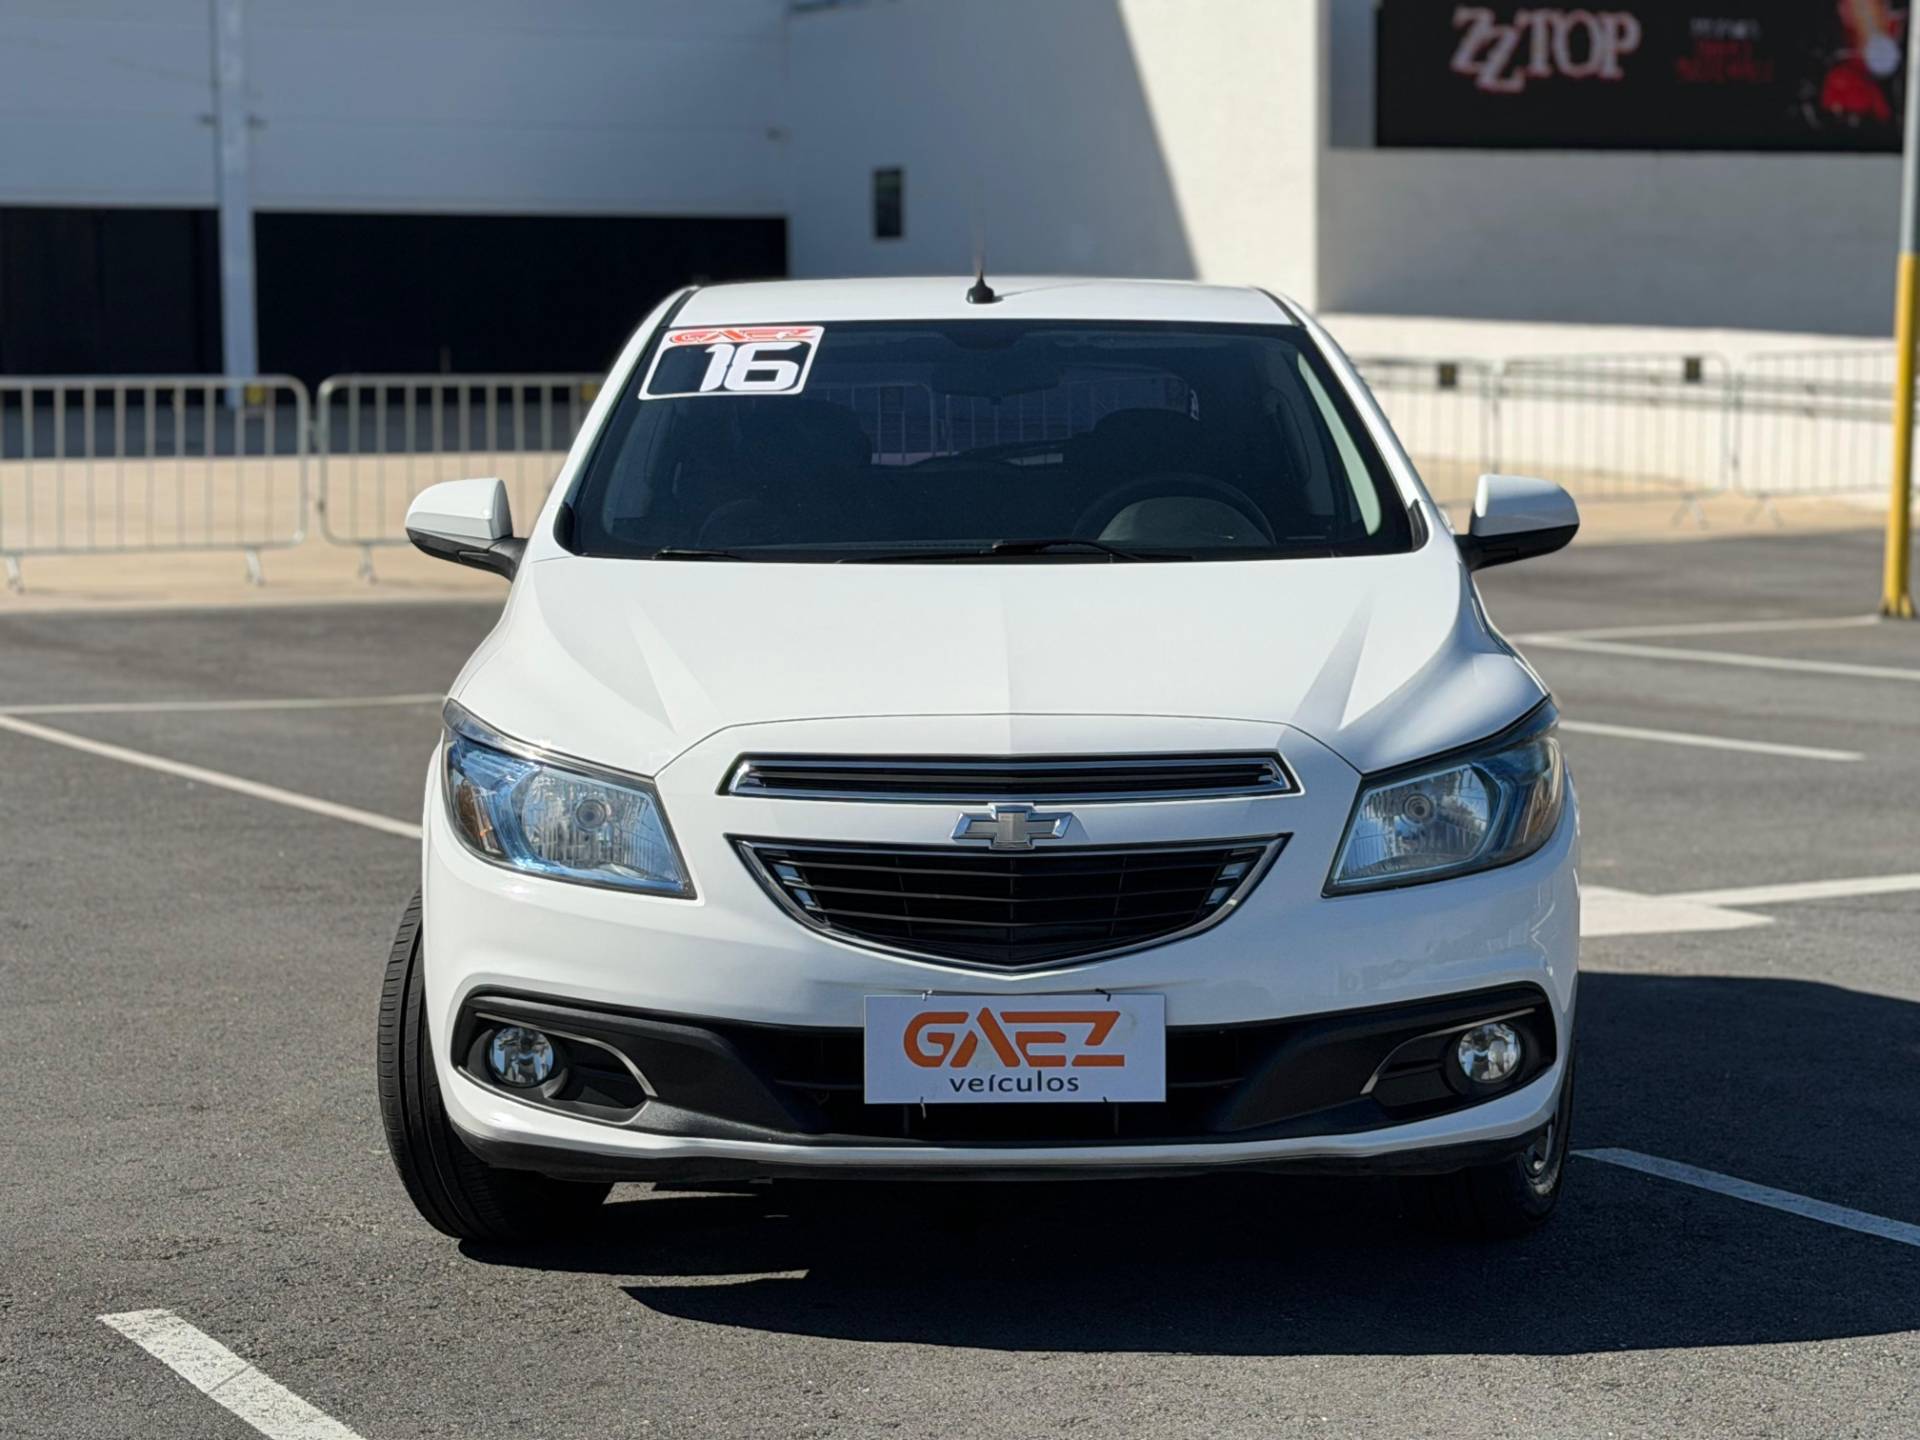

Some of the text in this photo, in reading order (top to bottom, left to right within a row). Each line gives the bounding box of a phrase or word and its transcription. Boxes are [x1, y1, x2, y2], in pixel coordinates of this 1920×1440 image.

[699, 341, 802, 393] 16
[903, 1006, 1125, 1069] GAEZ
[949, 1069, 1080, 1093] veículos
